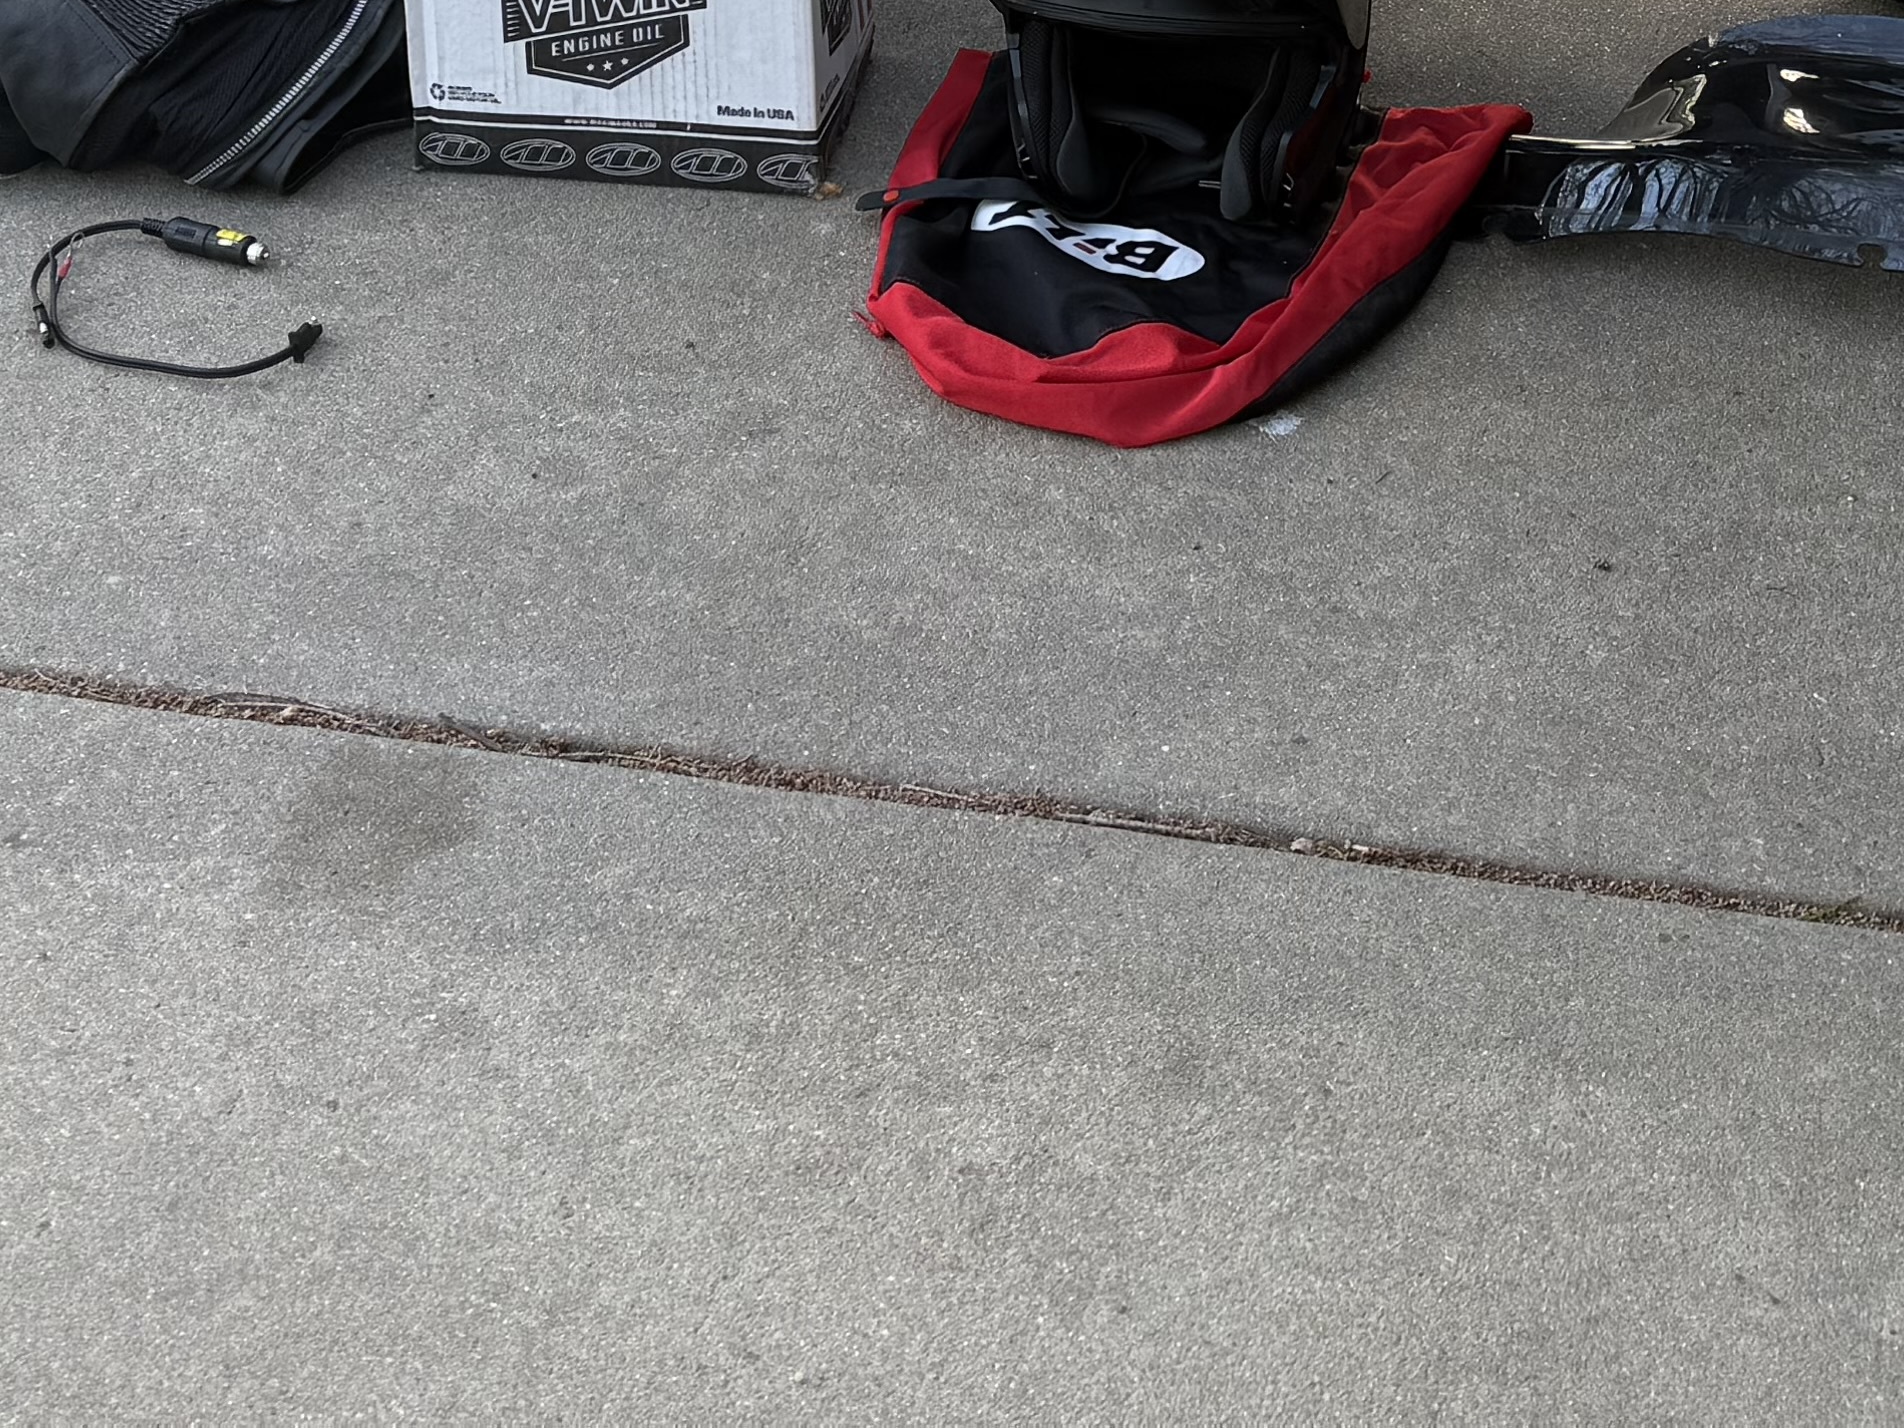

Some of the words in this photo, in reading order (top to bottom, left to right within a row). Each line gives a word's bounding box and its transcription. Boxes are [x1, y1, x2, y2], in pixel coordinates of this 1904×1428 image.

[551, 32, 627, 56] ENGINE
[632, 24, 667, 44] OIL
[717, 105, 751, 119] Made
[766, 108, 795, 122] USA
